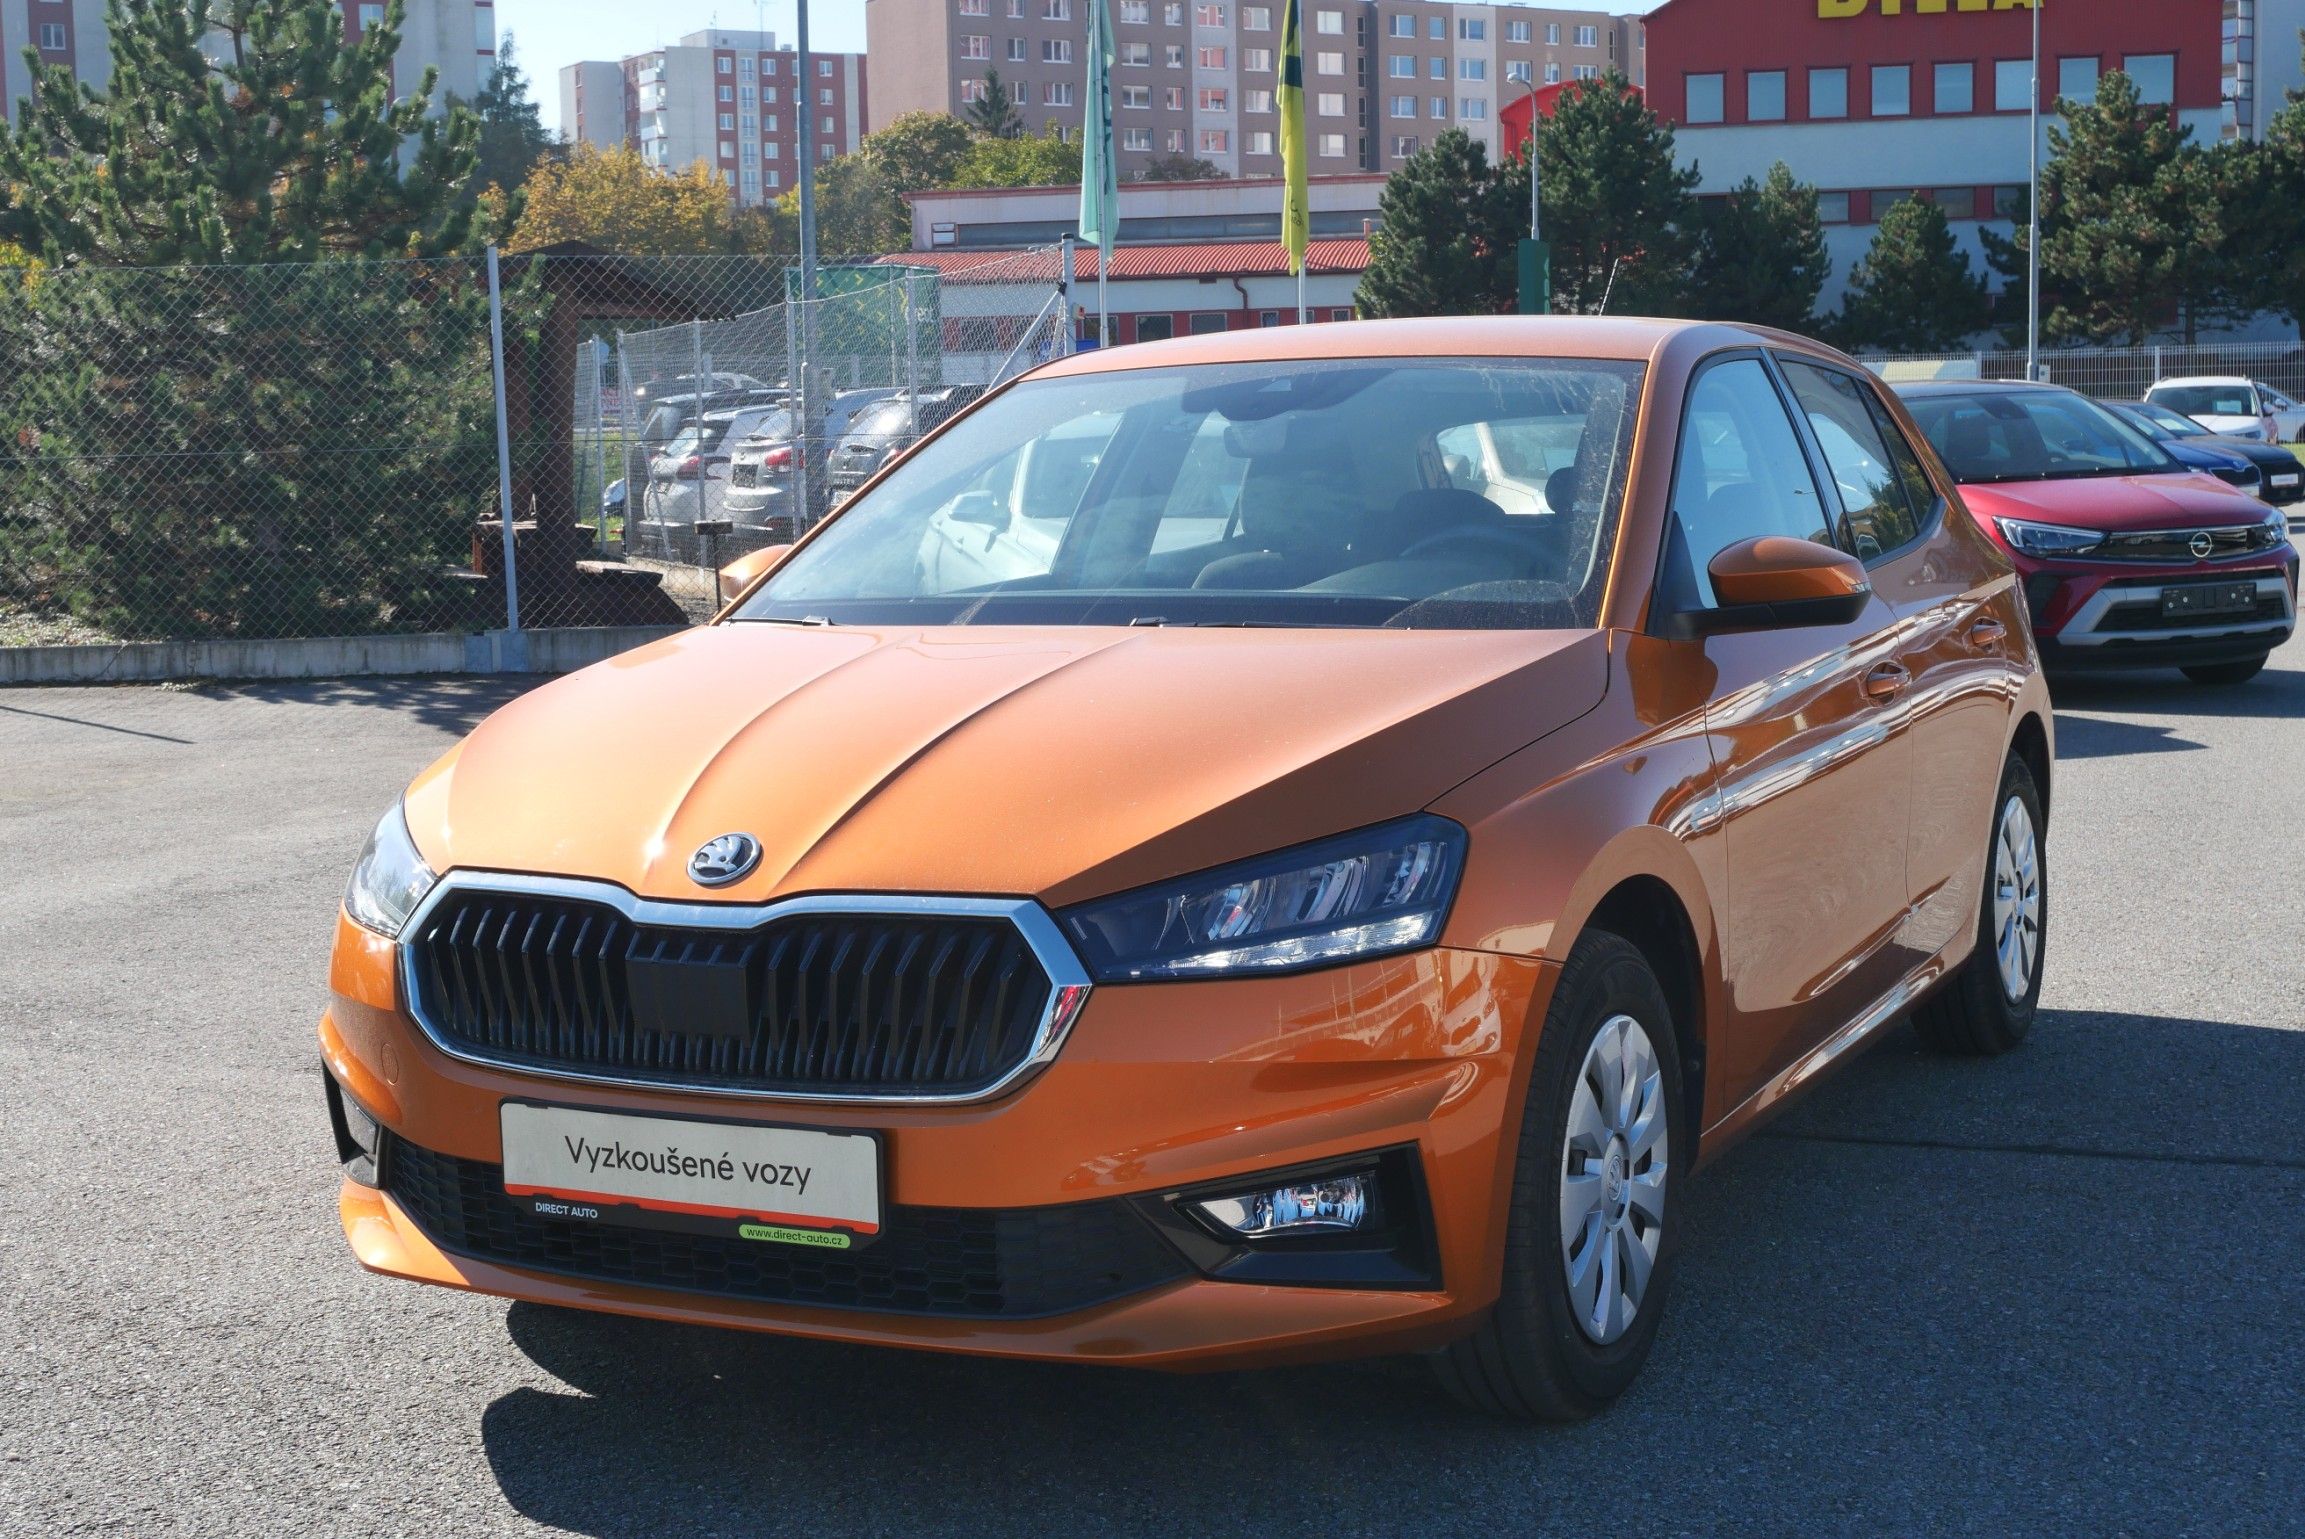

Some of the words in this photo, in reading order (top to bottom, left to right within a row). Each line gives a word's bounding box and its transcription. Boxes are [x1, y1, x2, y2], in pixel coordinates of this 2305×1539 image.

[564, 1135, 734, 1181] Vyzkoušené
[742, 1161, 812, 1195] vozy
[535, 1202, 569, 1215] DIRECT
[571, 1207, 598, 1218] AUTO
[746, 1228, 843, 1246] www.direct-auto.cz
